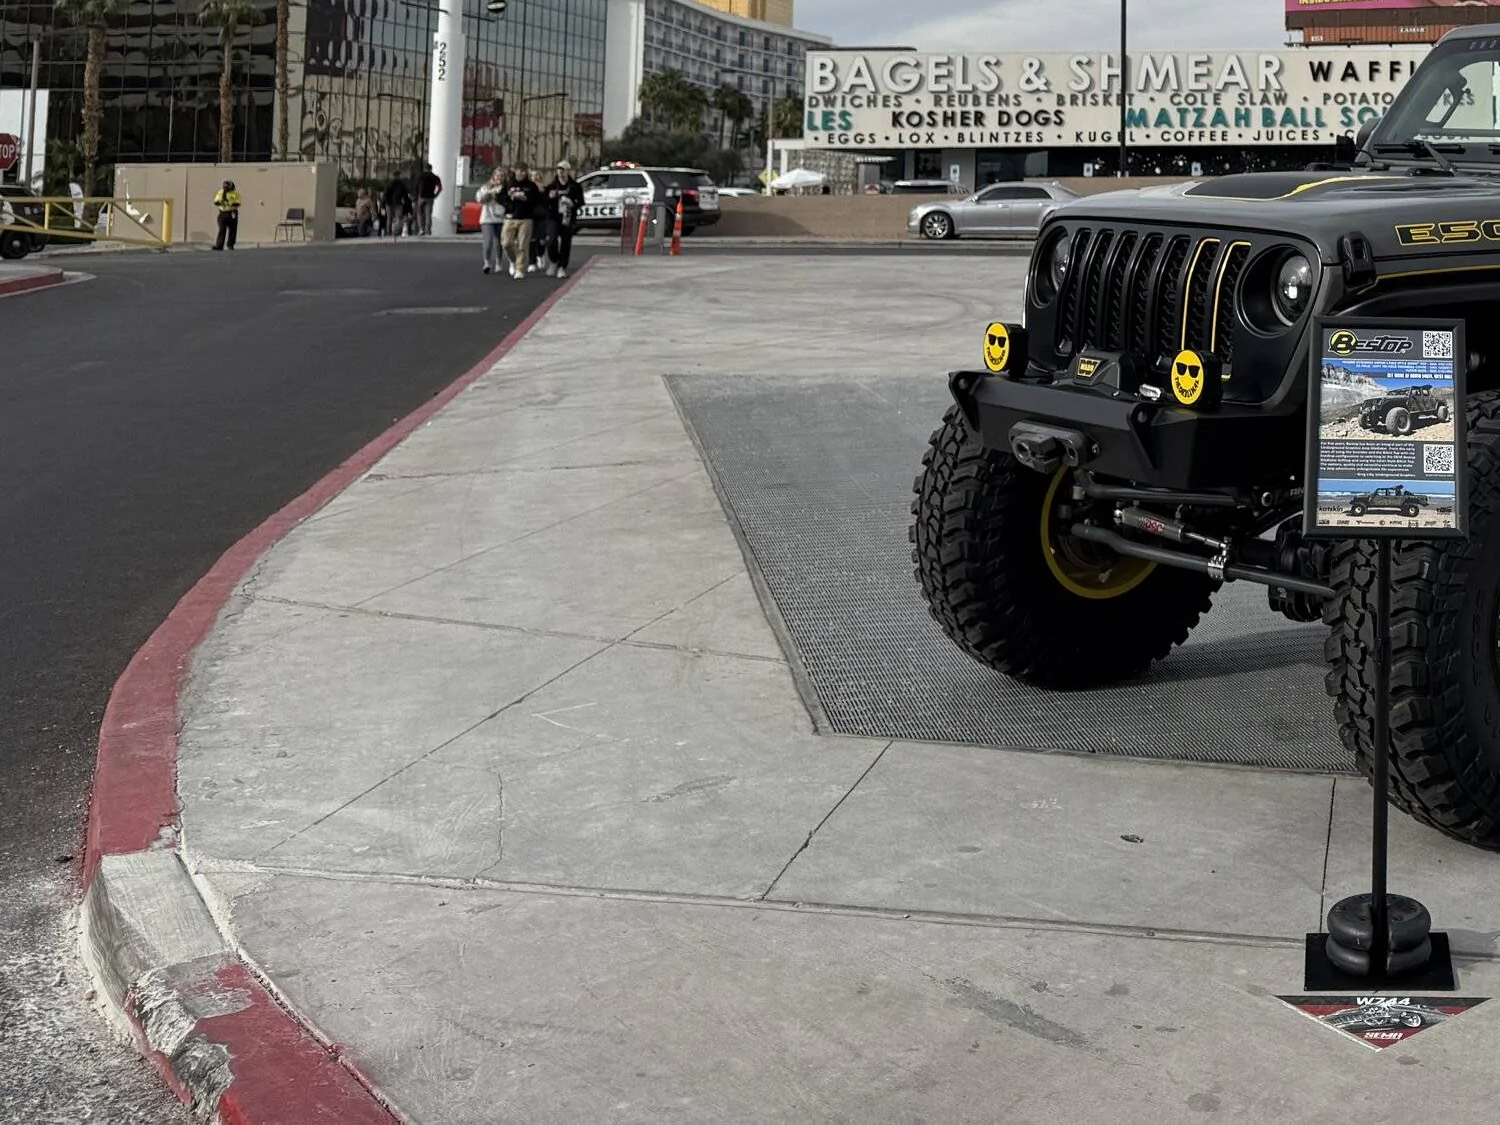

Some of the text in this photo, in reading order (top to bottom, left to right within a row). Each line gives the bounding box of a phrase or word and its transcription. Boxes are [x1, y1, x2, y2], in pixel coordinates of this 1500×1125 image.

[812, 54, 1285, 94] BAGELS & SHMEAR
[808, 92, 1395, 108] DWICHES REUBENS BRISKET COLE SLAW POTATO
[807, 110, 853, 131] LES
[892, 110, 985, 127] KOSHER
[998, 109, 1066, 126] DOGS
[1125, 108, 1252, 129] MATZAH
[1261, 107, 1328, 128] BALL
[827, 129, 1320, 145] EGGS LOX BLINTZES KUGEL COFFEE JUICES
[0, 144, 15, 159] TOP
[576, 206, 616, 217] OLICE
[1328, 331, 1413, 355] BESTOP
